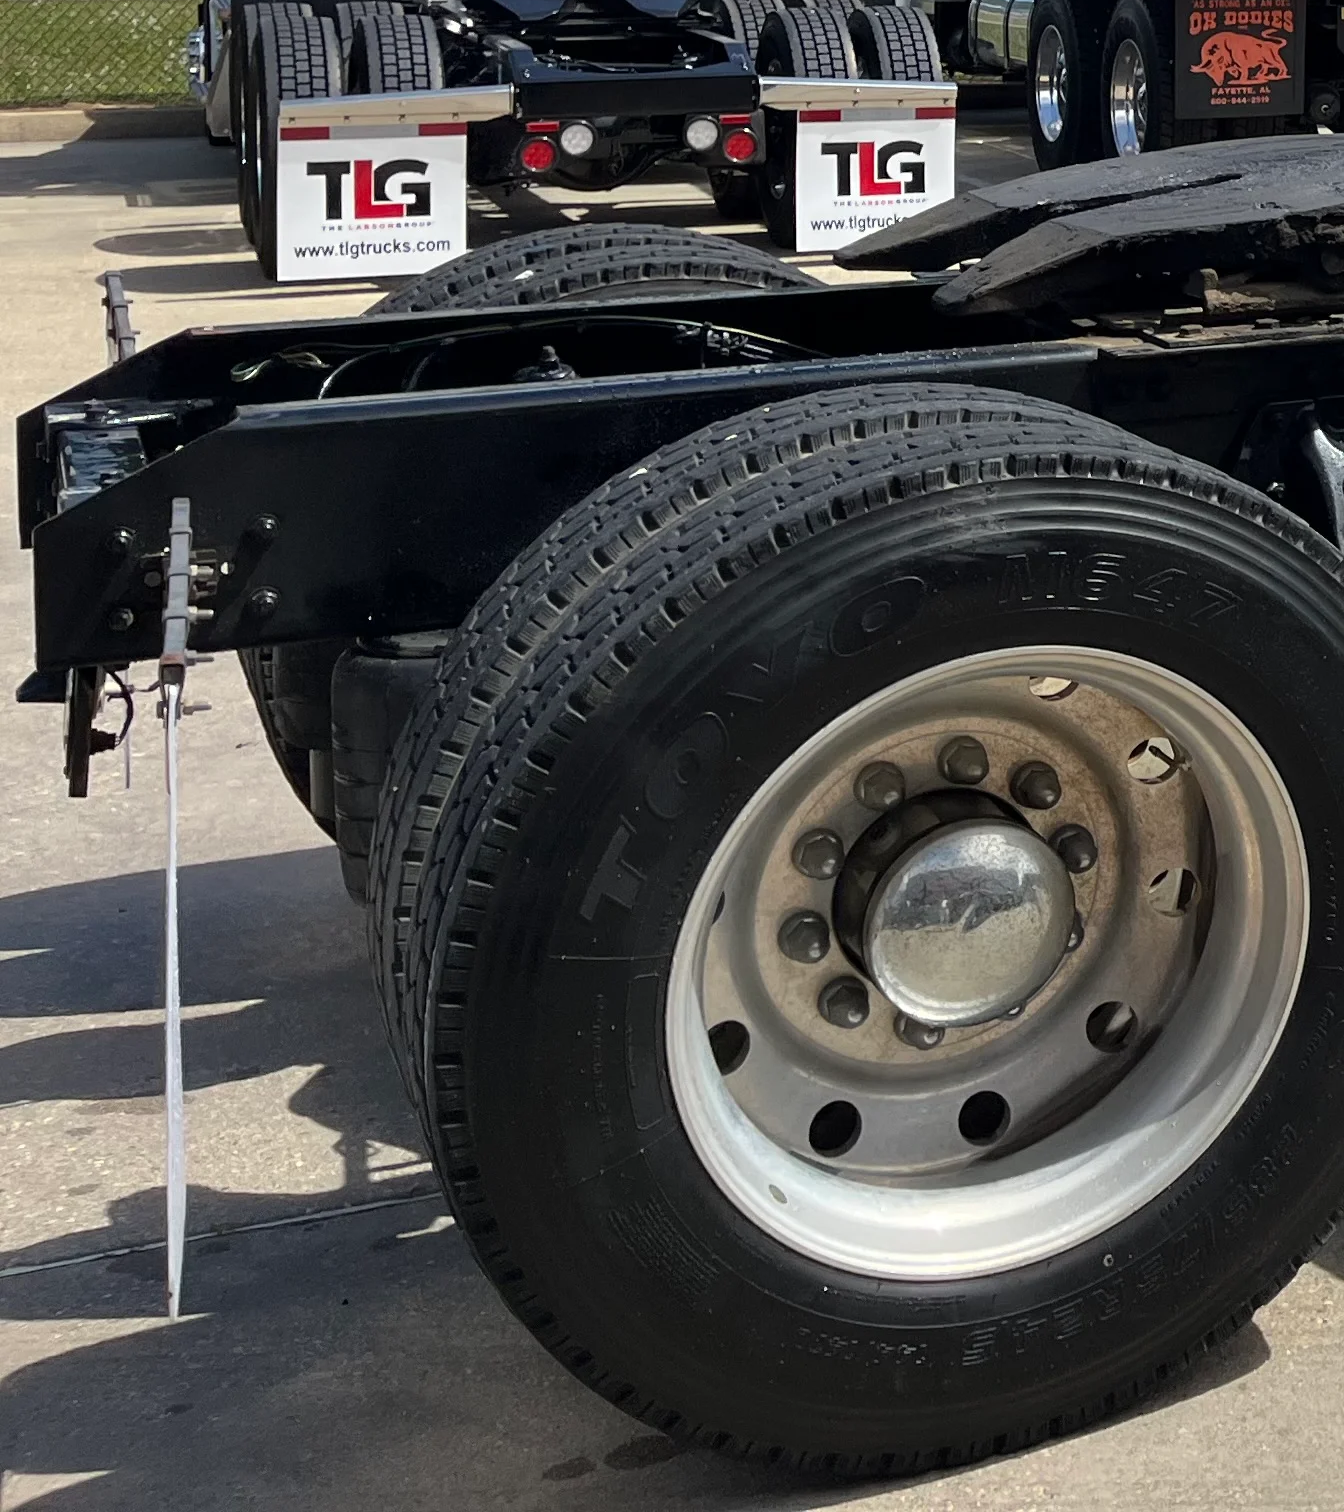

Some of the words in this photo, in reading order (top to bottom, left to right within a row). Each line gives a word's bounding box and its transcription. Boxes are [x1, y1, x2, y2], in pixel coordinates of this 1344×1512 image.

[1188, 11, 1217, 35] OX
[306, 158, 432, 221] TLG
[821, 140, 926, 197] TLG
[294, 238, 451, 260] www.tlgtrucks.com
[997, 548, 1245, 629] M647
[579, 574, 928, 921] TOYO
